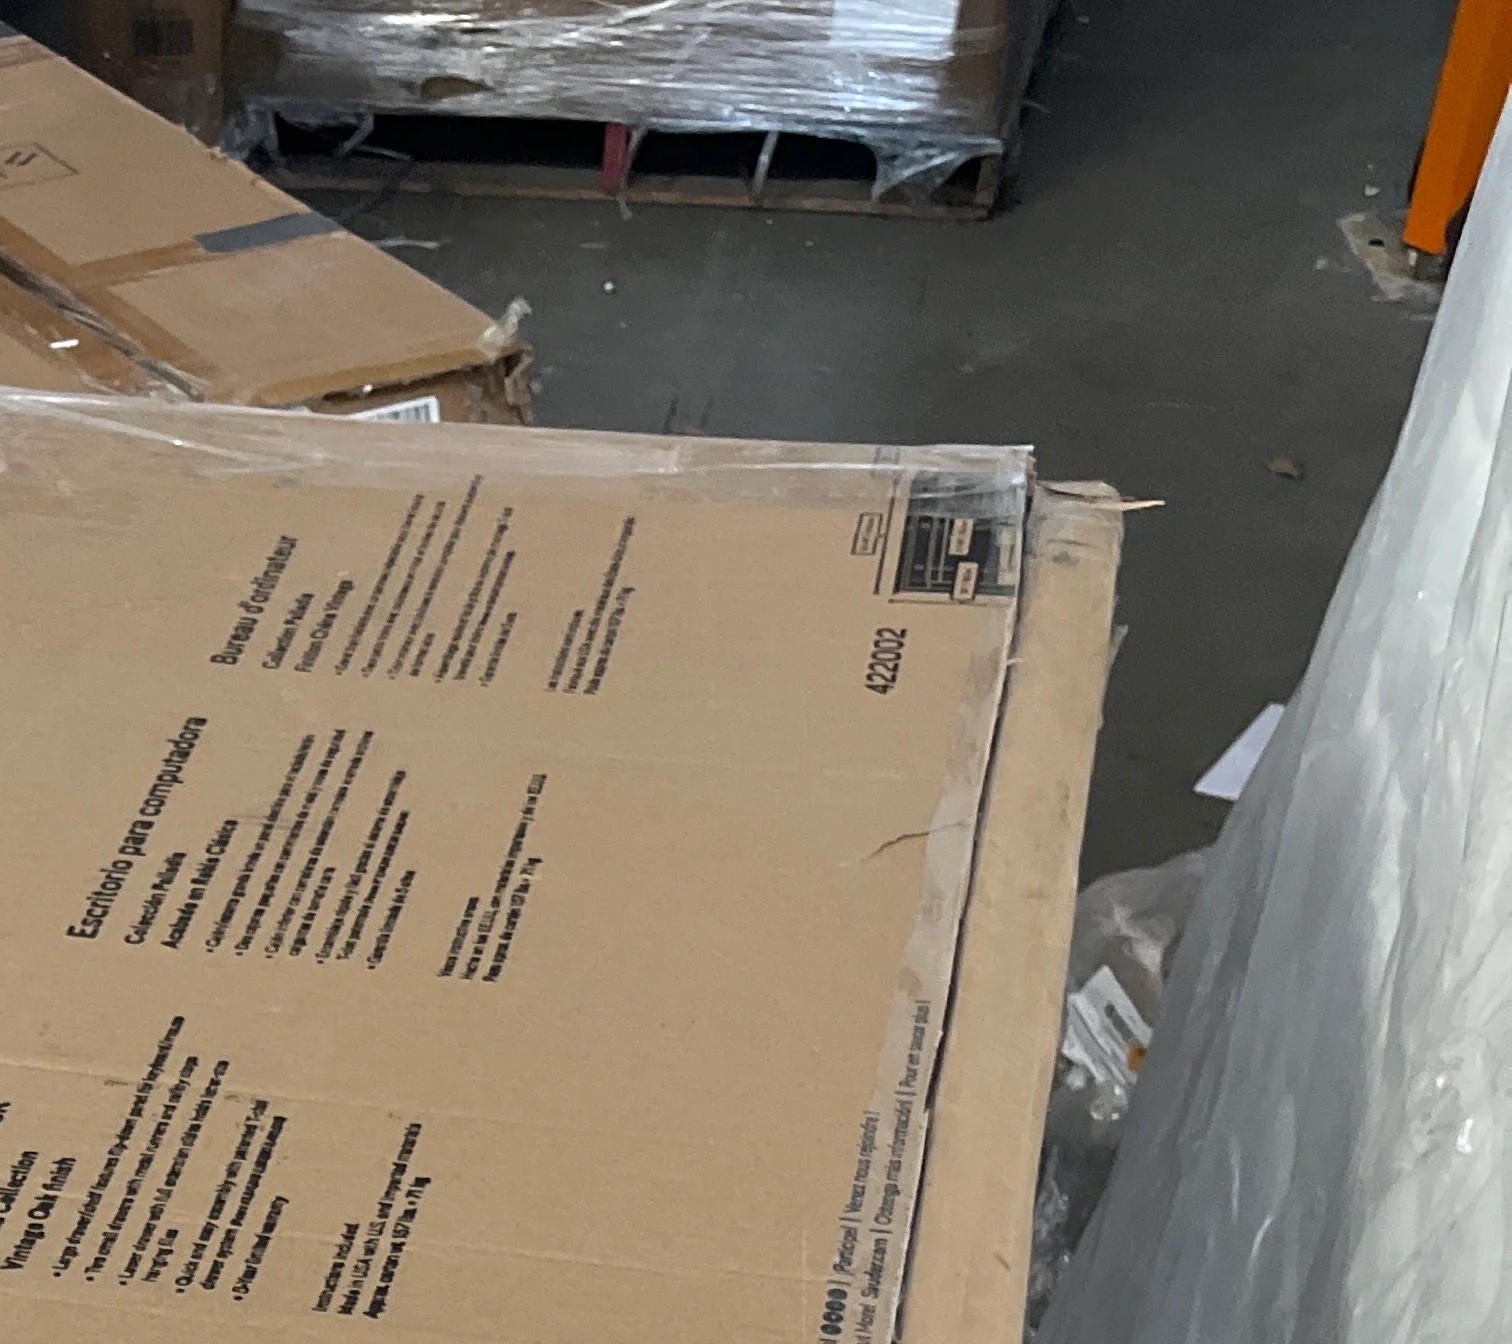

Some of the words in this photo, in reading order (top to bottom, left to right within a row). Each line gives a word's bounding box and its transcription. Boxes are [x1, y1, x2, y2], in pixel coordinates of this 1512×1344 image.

[210, 617, 258, 665] Bureau
[864, 627, 908, 695] 422002
[66, 860, 133, 938] Escritorio
[118, 820, 155, 856] para
[139, 717, 207, 816] computadora
[188, 888, 205, 900] en
[42, 1158, 76, 1191] finish
[28, 1194, 58, 1220] Oak
[0, 1223, 45, 1269] Vintage
